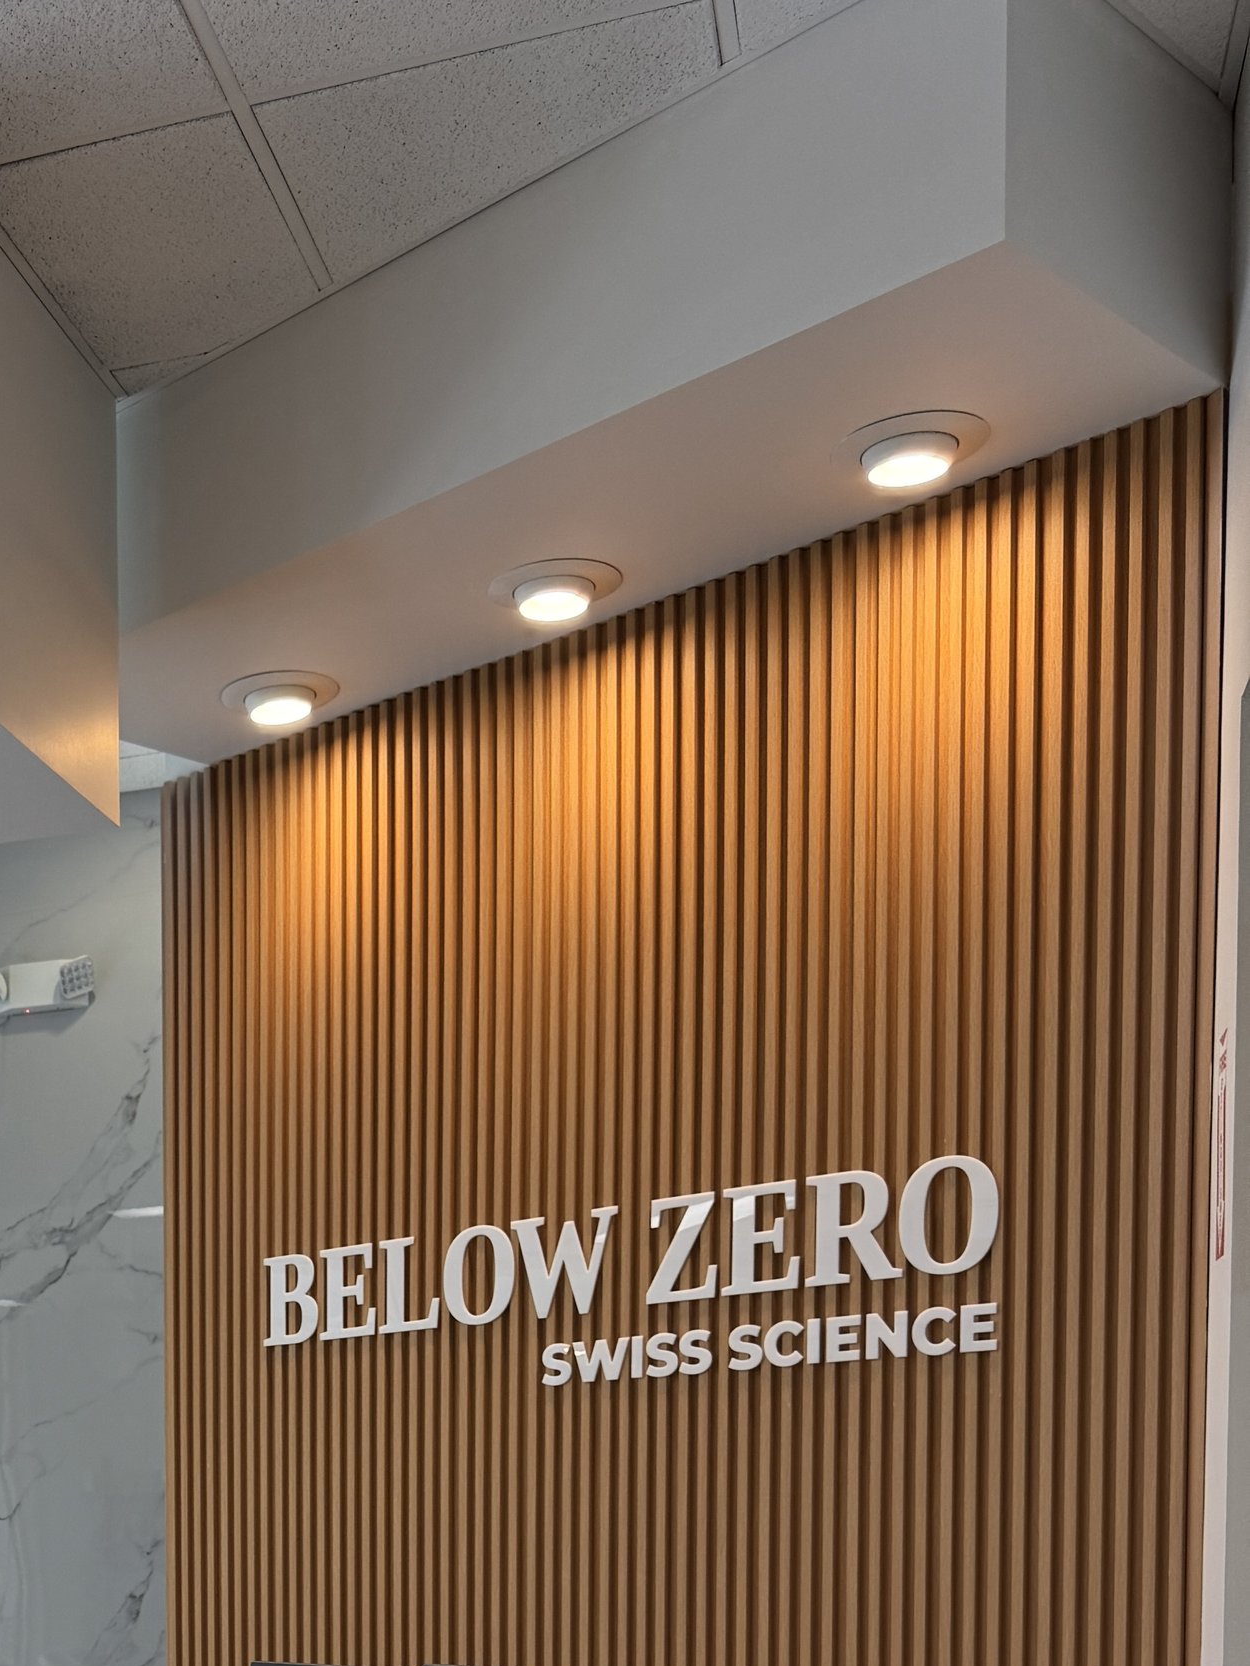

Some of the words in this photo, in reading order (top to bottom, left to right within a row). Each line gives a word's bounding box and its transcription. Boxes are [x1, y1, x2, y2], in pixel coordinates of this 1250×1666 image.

[263, 1205, 618, 1347] BELOW
[645, 1154, 999, 1305] ZERO
[541, 1329, 712, 1387] SWISS
[728, 1302, 998, 1371] SCIENCE
